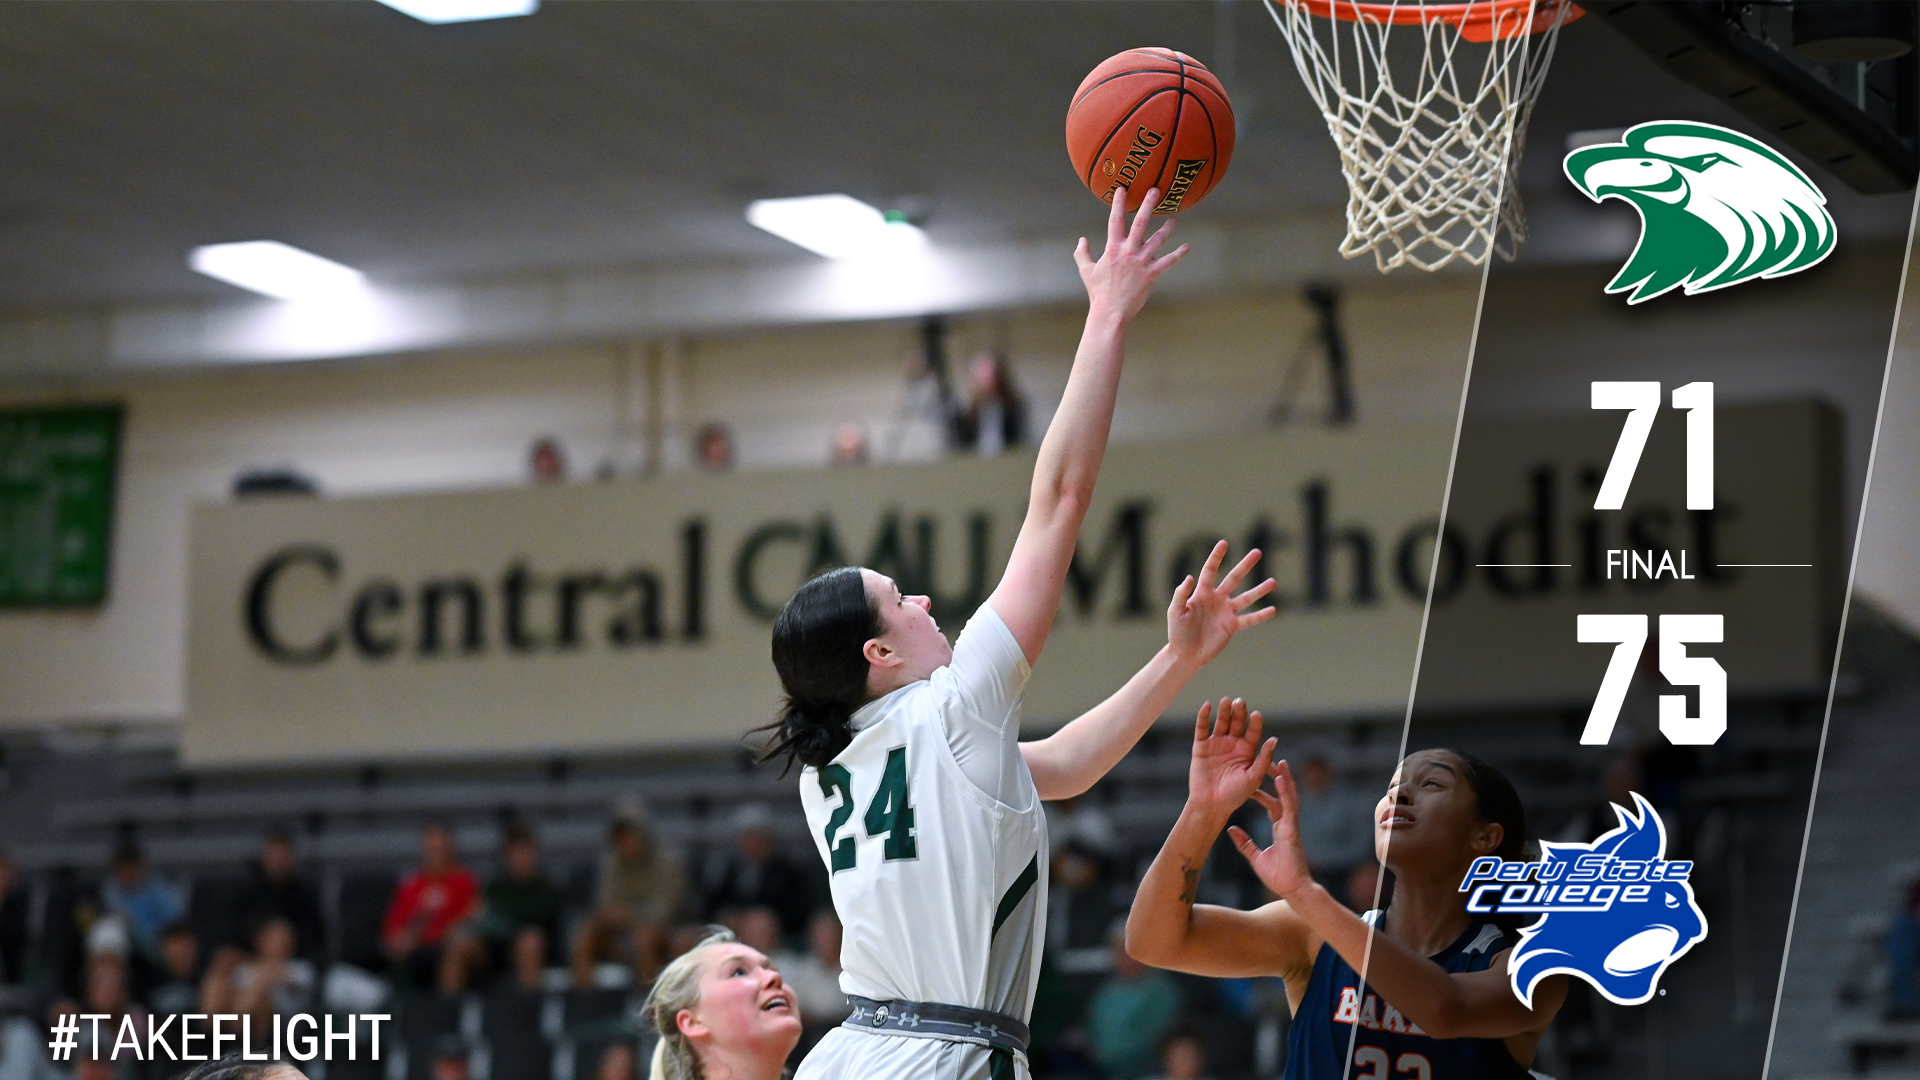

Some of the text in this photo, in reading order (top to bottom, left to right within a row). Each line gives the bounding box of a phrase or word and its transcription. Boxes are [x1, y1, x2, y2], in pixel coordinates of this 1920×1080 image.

[243, 518, 708, 666] Central
[817, 745, 919, 879] 24
[1333, 986, 1430, 1037] BAK
